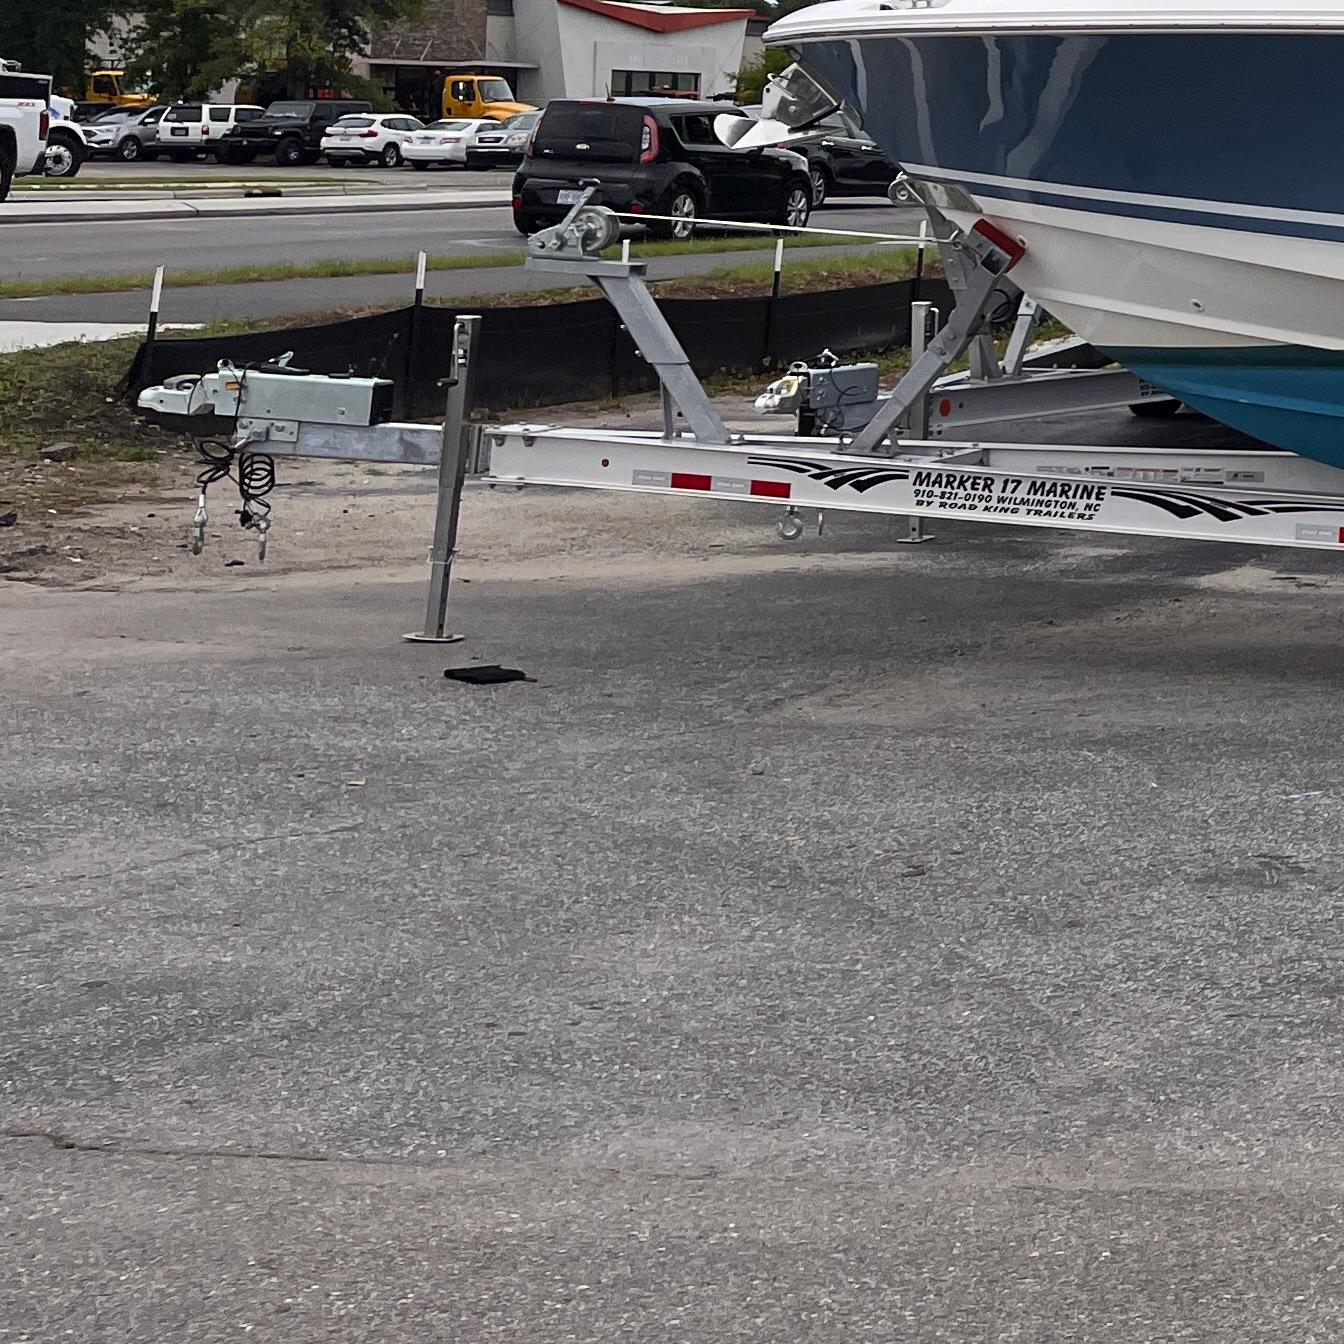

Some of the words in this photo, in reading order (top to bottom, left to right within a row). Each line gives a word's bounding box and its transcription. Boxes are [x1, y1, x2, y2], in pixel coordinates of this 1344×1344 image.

[912, 471, 995, 493] MARKER
[1000, 478, 1023, 494] 17
[1026, 480, 1107, 502] MARINE
[913, 488, 993, 504] 910-821-0190
[996, 495, 1079, 512] WILMINGTON,
[1083, 502, 1101, 512] NC
[938, 501, 978, 511] ROAD
[982, 505, 1020, 514] KING
[1026, 508, 1096, 521] TRAILERS
